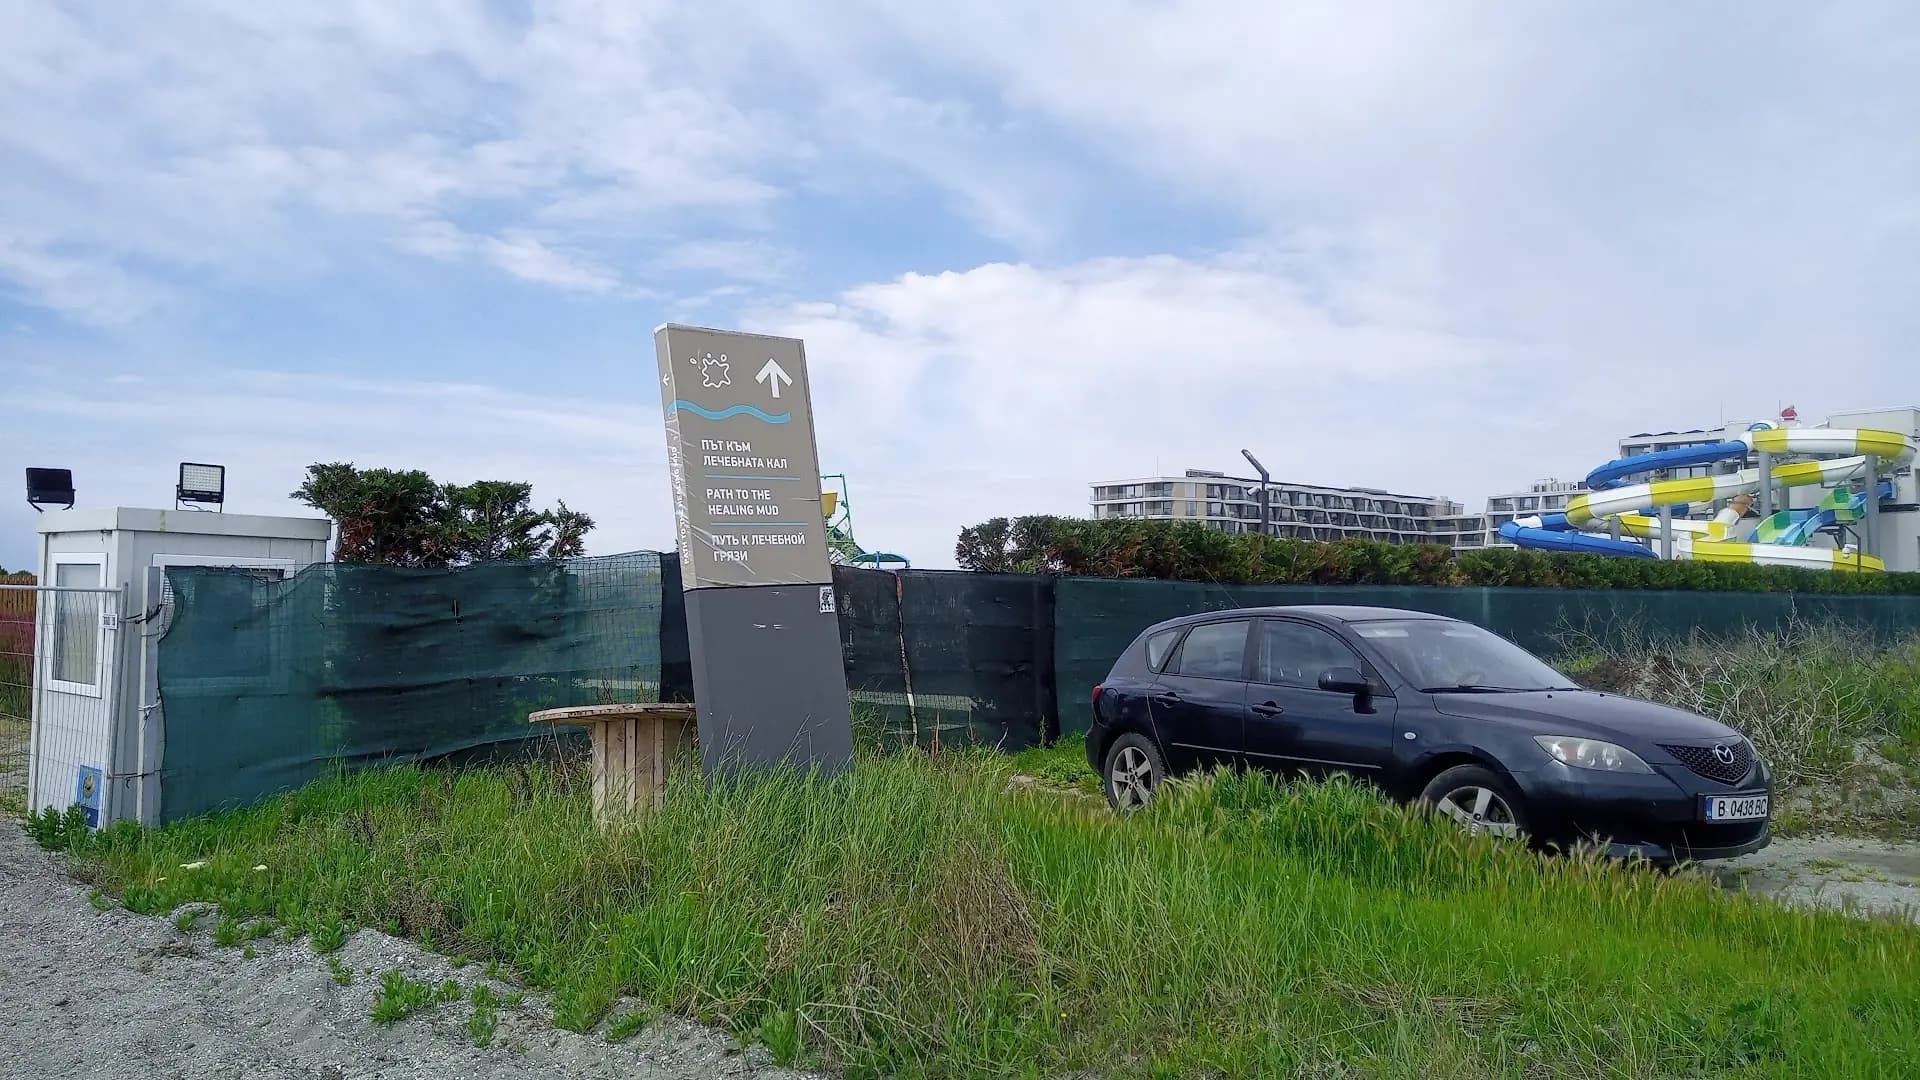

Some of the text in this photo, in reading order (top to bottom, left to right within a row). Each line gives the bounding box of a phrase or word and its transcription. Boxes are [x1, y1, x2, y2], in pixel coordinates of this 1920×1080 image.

[701, 439, 751, 452] ПЪТ КЪМ
[703, 455, 787, 469] ЛЕЧЕБНАТА КАЛ
[706, 488, 771, 500] PATH TO THE
[708, 504, 779, 515] HEALING MUD
[680, 528, 687, 540] TO
[711, 531, 806, 546] ПУТЬ К ЛЕЧЕБНОЙ
[681, 541, 690, 564] PATH
[713, 550, 748, 562] ГРЯЗИ
[1718, 800, 1725, 816] B
[1730, 799, 1753, 816] 0438
